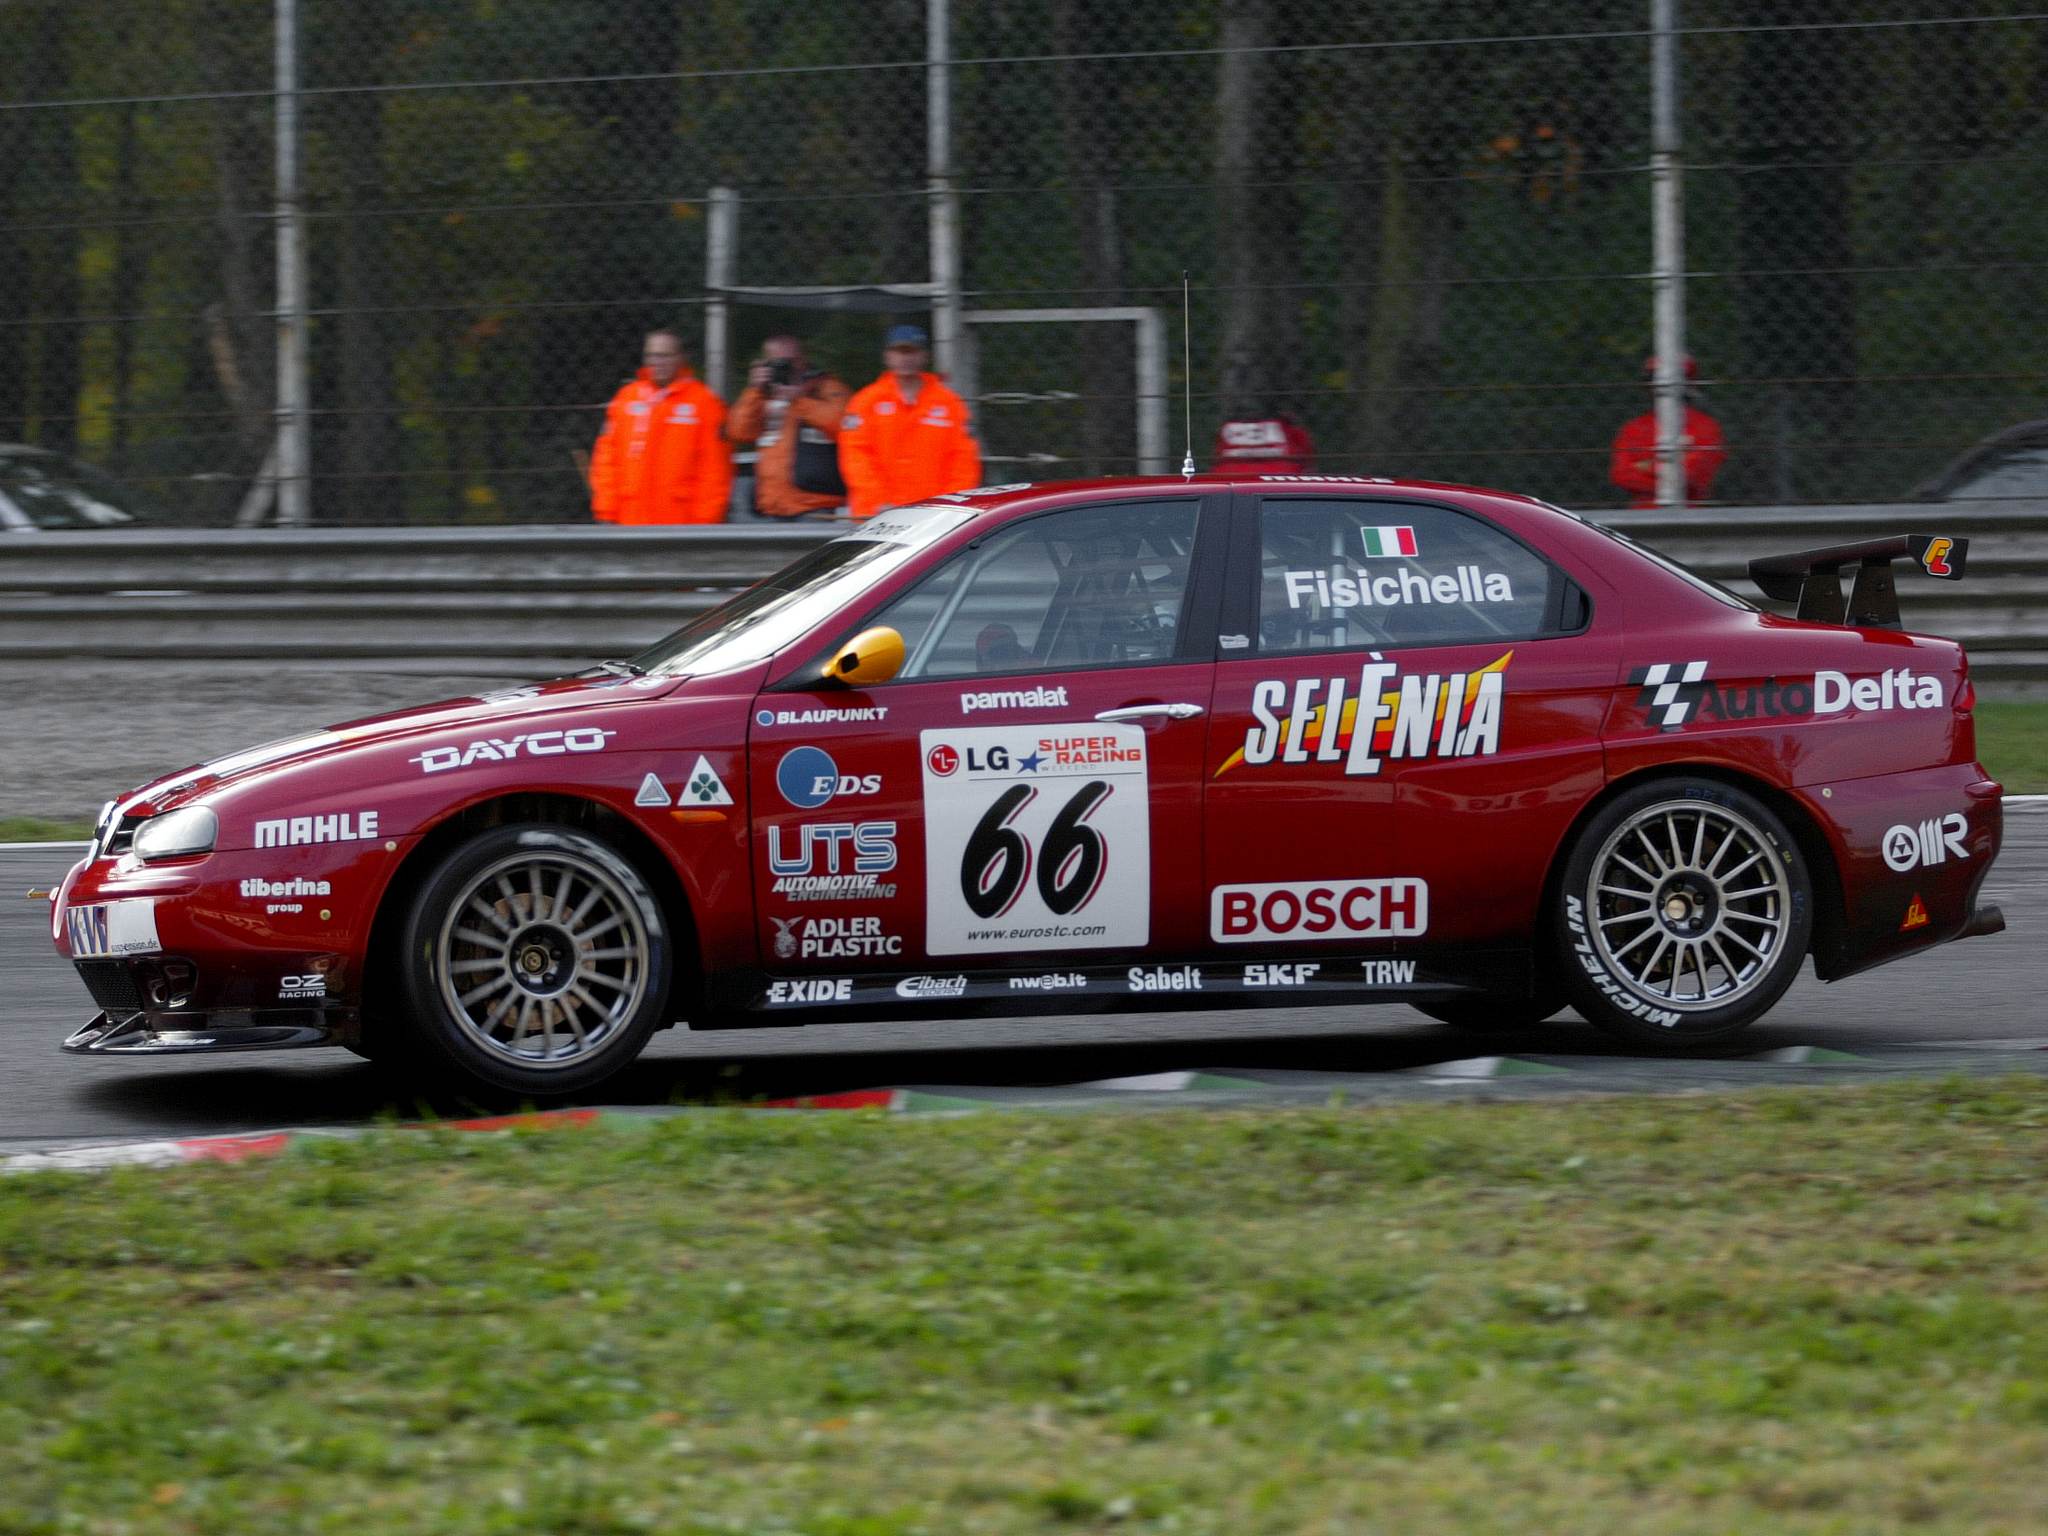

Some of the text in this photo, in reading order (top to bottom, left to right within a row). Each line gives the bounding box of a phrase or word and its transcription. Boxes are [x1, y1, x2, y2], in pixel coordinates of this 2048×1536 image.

[1284, 565, 1514, 609] Fisichella
[960, 686, 1069, 714] parmalat
[777, 707, 888, 725] BLAUPUNKT
[410, 727, 616, 773] DAYCO
[1038, 736, 1117, 751] SUPER
[966, 745, 1010, 771] LG
[1056, 749, 1141, 764] RACING
[810, 774, 882, 796] EDS
[254, 811, 379, 849] MAHLE
[768, 820, 898, 876] UTS
[960, 780, 1115, 919] 66
[239, 877, 331, 897] tiberina
[771, 874, 879, 893] AUTOMOTIVE
[787, 883, 898, 902] ENGINEERING
[266, 902, 303, 914] group
[1222, 885, 1417, 936] BOSCH
[802, 917, 882, 938] ADLER
[967, 923, 1107, 942] www.eurostc.com
[801, 935, 903, 959] PLASTIC
[1361, 960, 1417, 985] TRW
[1566, 894, 1683, 1028] MICHELIN
[896, 974, 968, 997] Eibach
[1128, 965, 1203, 992] Sabelt
[1243, 964, 1320, 986] SKF
[278, 990, 326, 1000] RACING
[766, 978, 854, 1003] EXIDE
